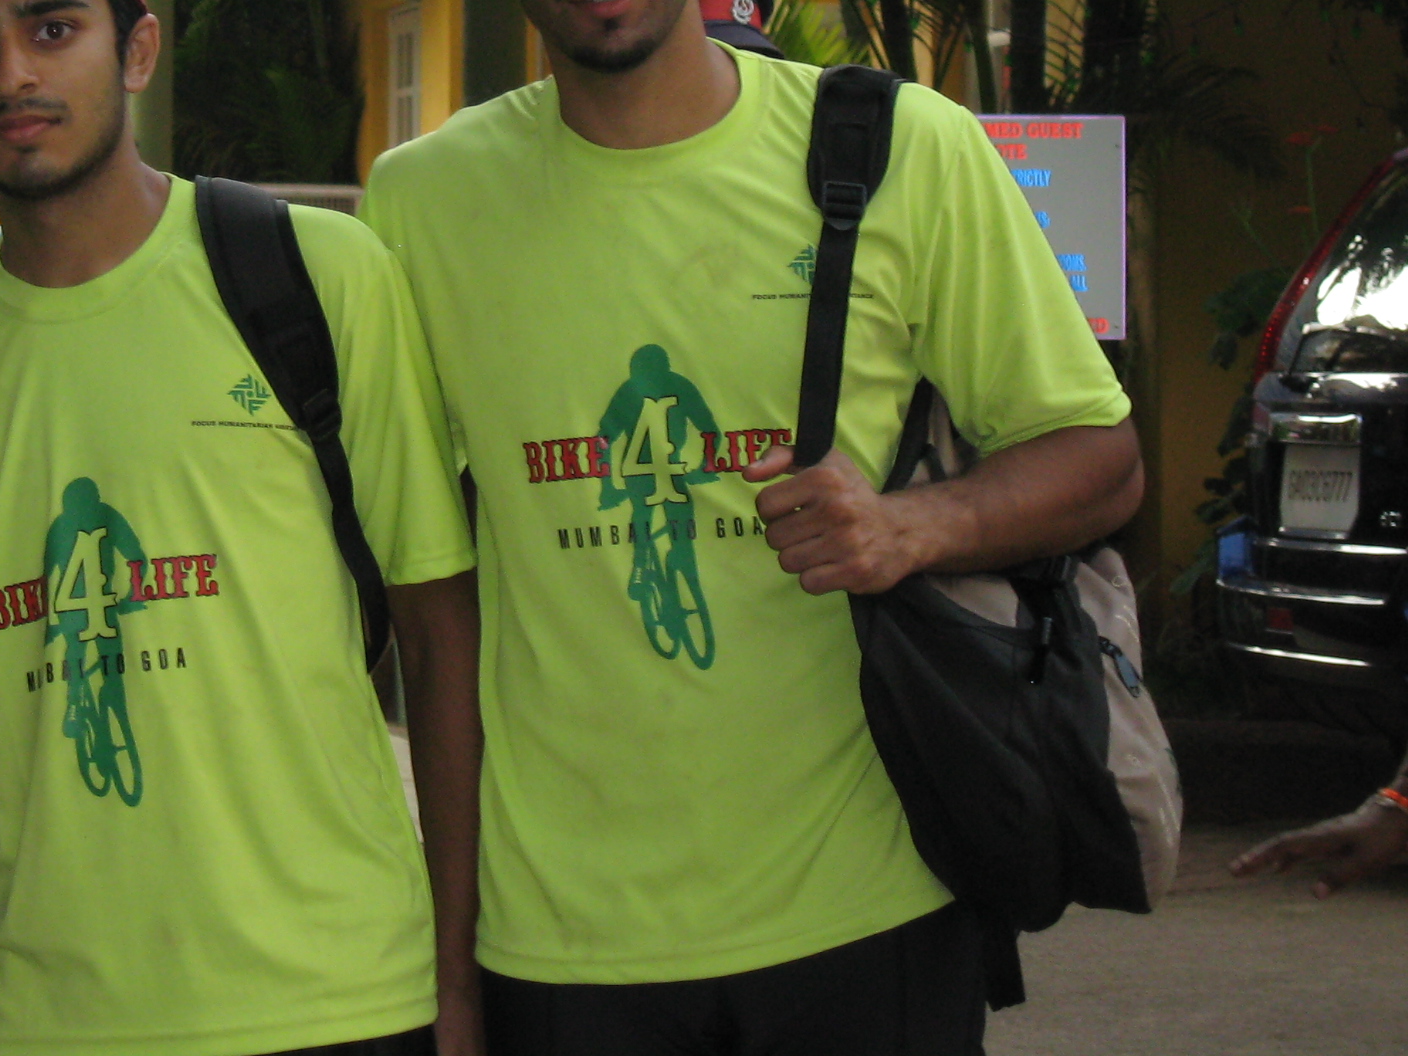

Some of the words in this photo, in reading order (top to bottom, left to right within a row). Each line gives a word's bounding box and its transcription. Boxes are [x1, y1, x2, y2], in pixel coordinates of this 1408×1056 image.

[1027, 122, 1084, 139] GUEST
[523, 435, 612, 483] BIKE
[622, 395, 690, 506] 4
[557, 520, 652, 549] MUMBAI
[54, 526, 119, 642] 4
[126, 553, 220, 602] LIFE
[141, 647, 187, 672] GOA
